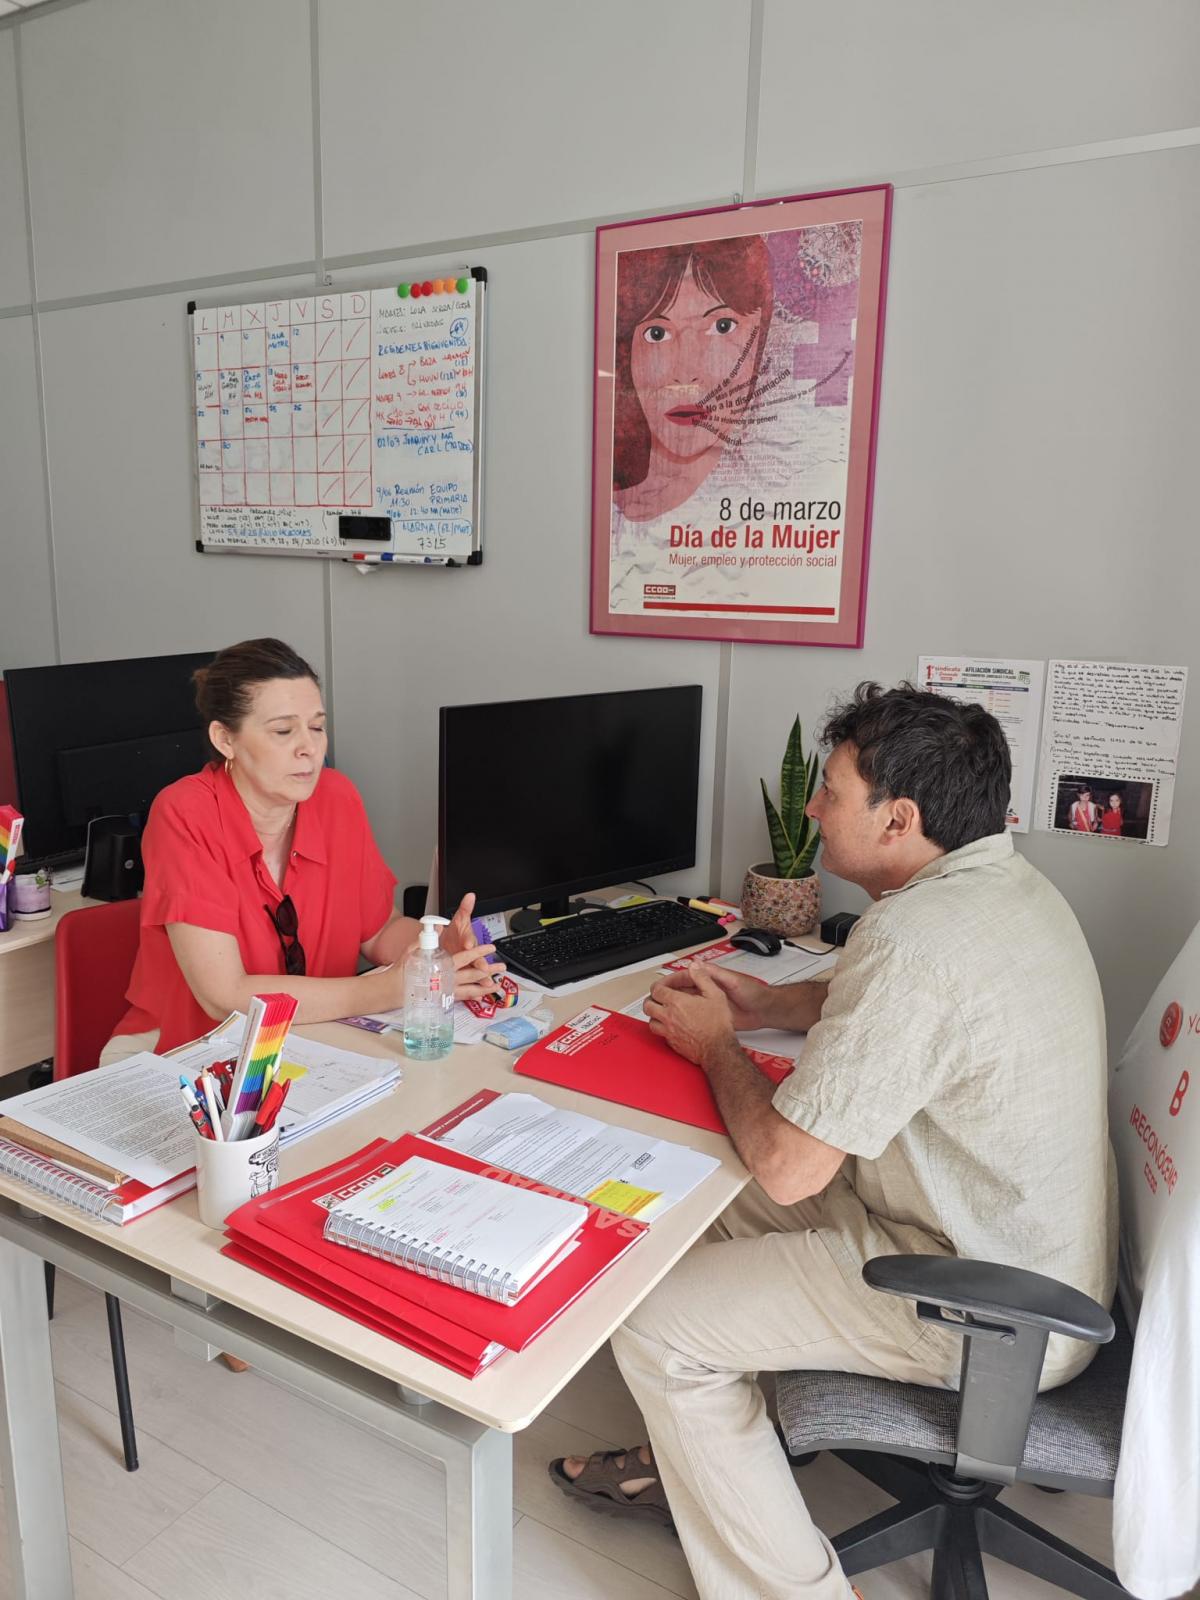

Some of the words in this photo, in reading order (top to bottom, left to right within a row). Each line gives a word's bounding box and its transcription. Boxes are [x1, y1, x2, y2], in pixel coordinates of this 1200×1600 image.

[224, 312, 234, 328] M
[247, 309, 261, 324] X
[269, 303, 282, 321] J
[296, 302, 307, 318] V
[321, 299, 334, 319] S
[351, 294, 366, 314] D
[729, 325, 760, 378] oportunidades
[726, 400, 733, 408] la
[735, 368, 791, 406] discriminación
[757, 415, 778, 425] género
[719, 497, 732, 521] 8
[740, 496, 765, 521] de
[773, 500, 841, 521] marzo
[417, 538, 447, 550] 7315
[669, 524, 703, 548] Día
[711, 525, 737, 549] de
[744, 525, 763, 549] la
[772, 524, 840, 554] Mujer
[669, 553, 698, 567] Mujer,
[701, 555, 737, 568] empleo
[740, 558, 748, 568] y
[749, 555, 803, 569] protección
[806, 556, 837, 568] social
[992, 667, 1014, 675] SINDICAL
